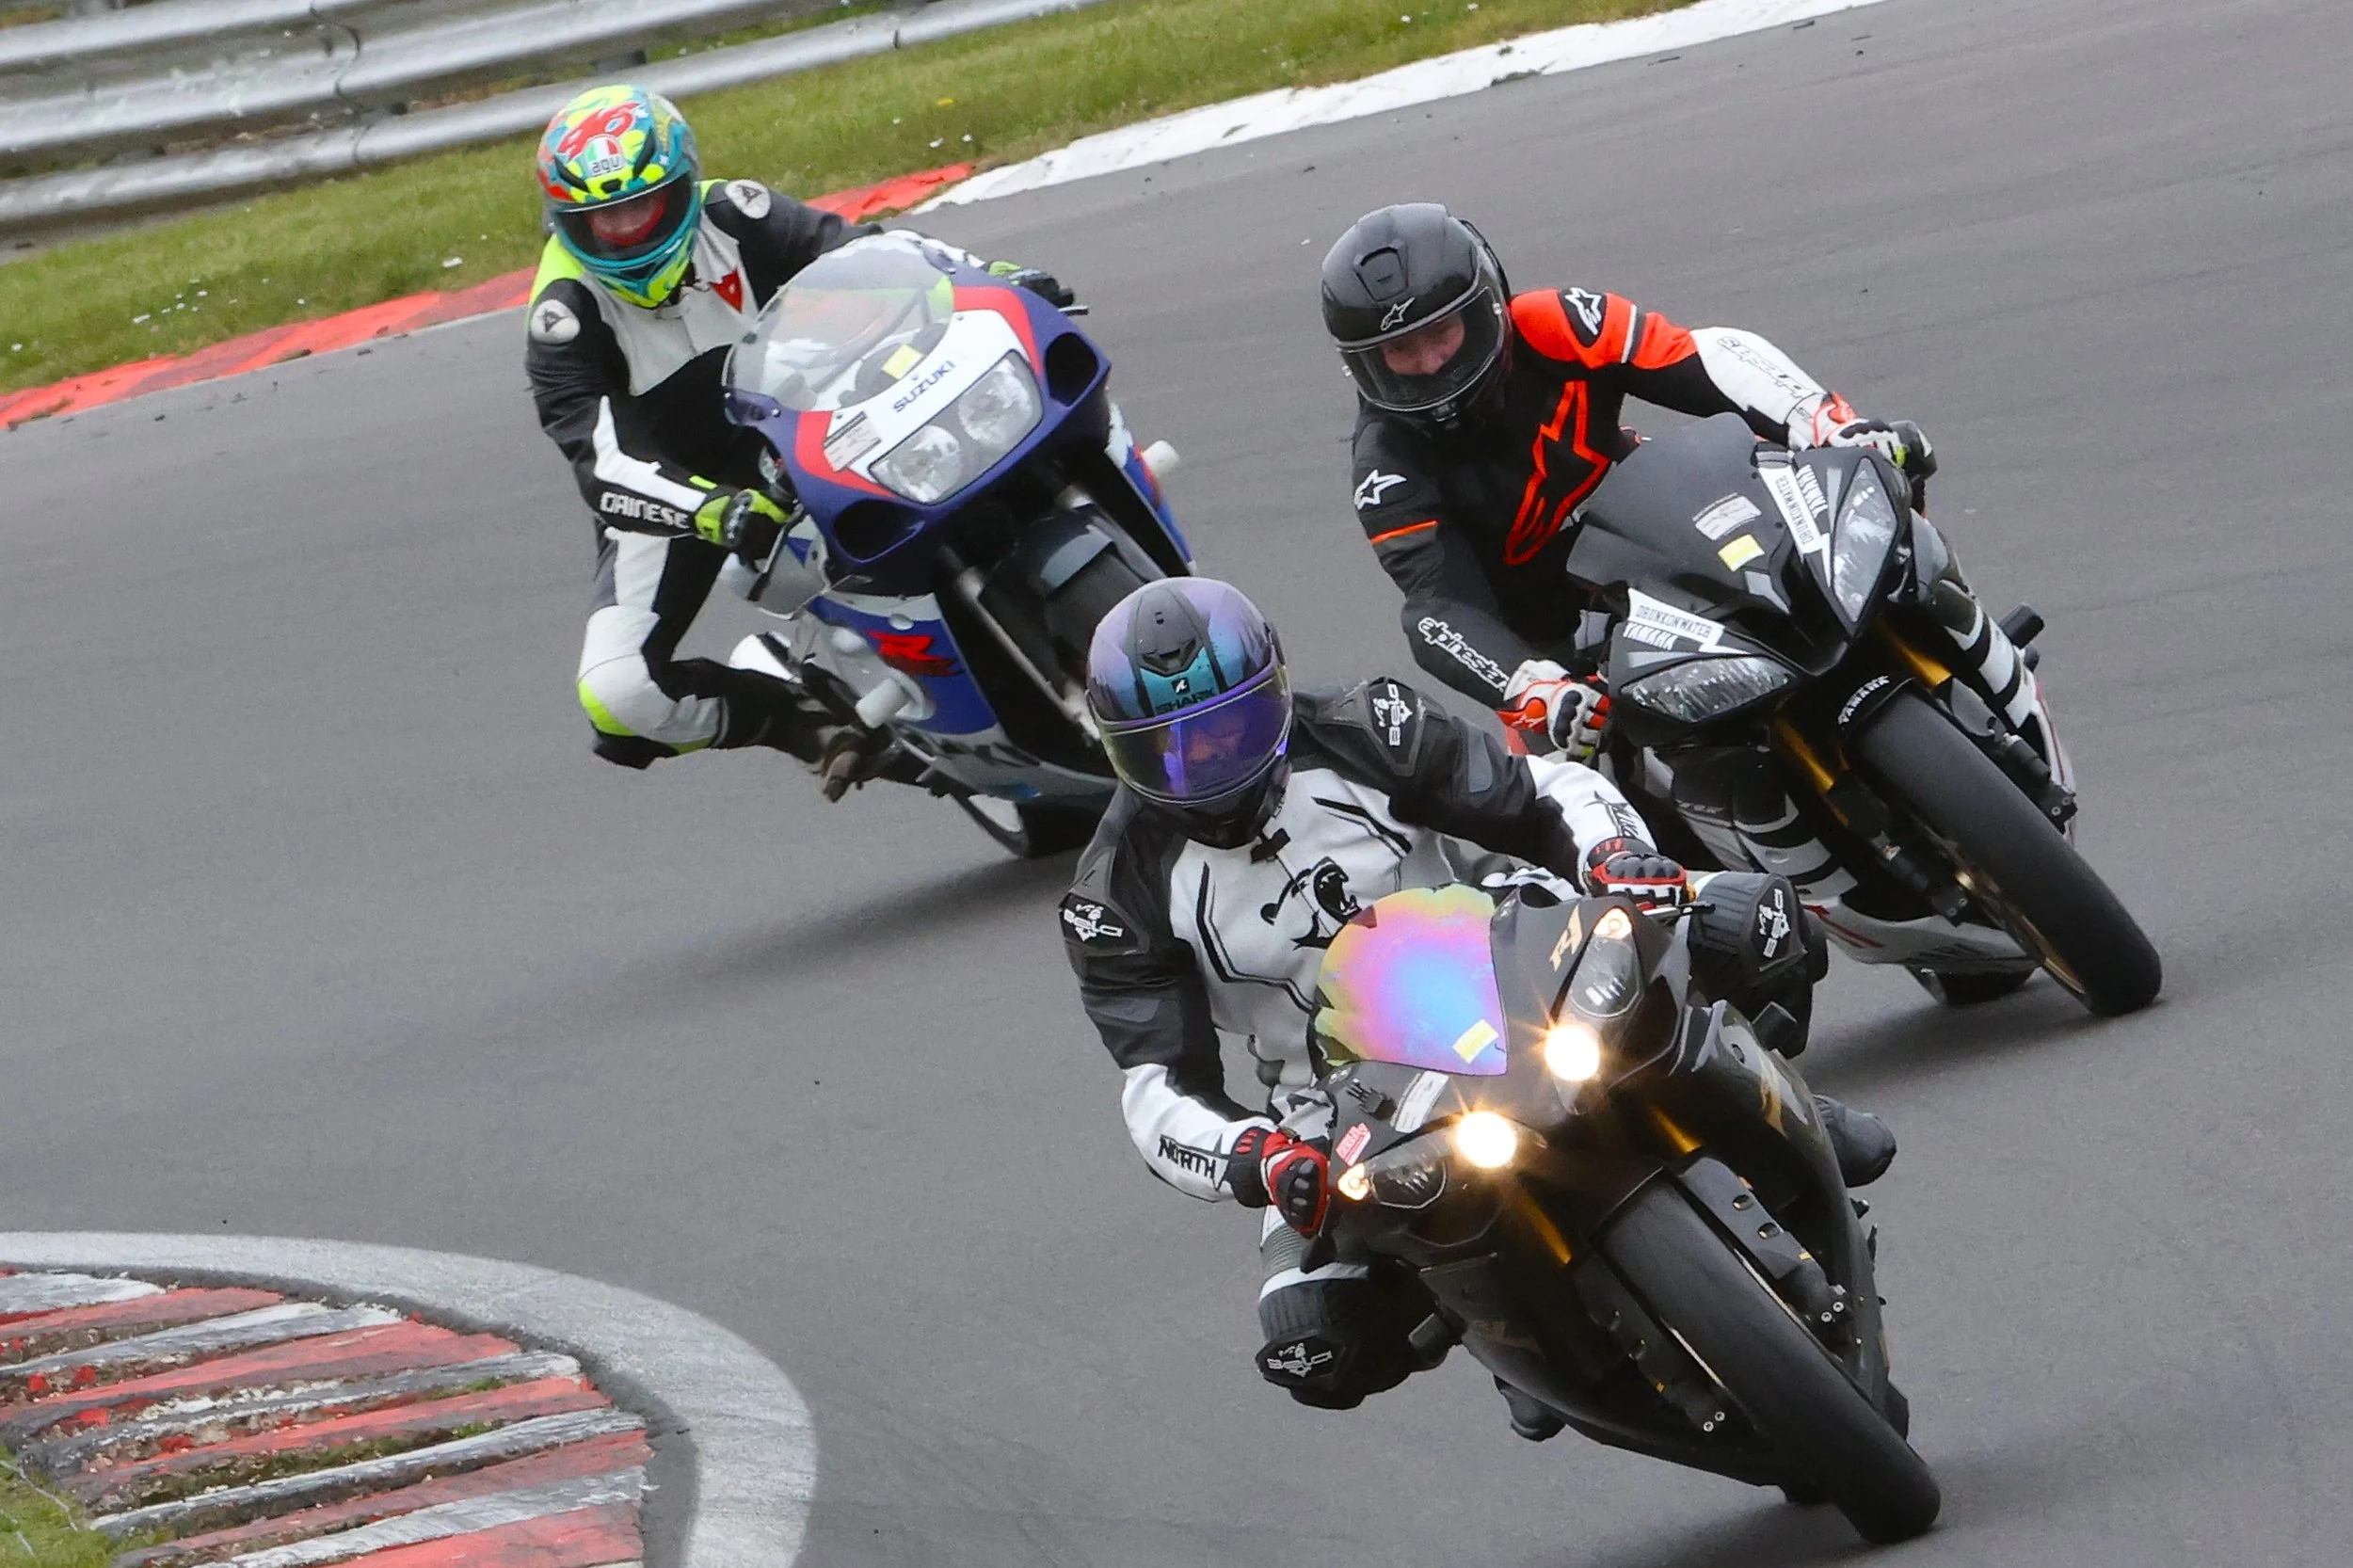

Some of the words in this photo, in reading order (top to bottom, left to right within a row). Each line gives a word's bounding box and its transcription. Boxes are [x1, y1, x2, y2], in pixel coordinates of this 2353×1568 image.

[893, 360, 956, 412] SUZUKI
[600, 491, 690, 529] DAINESE
[1775, 474, 1815, 545] DRUNKONWATER
[1796, 464, 1829, 518] YAMAHA
[1623, 621, 1678, 650] YAMAHA
[1636, 605, 1713, 638] DRUNKONWATER
[1417, 616, 1510, 693] alpinestar
[1158, 687, 1215, 712] SHARK
[1837, 675, 1890, 725] YAMAHA
